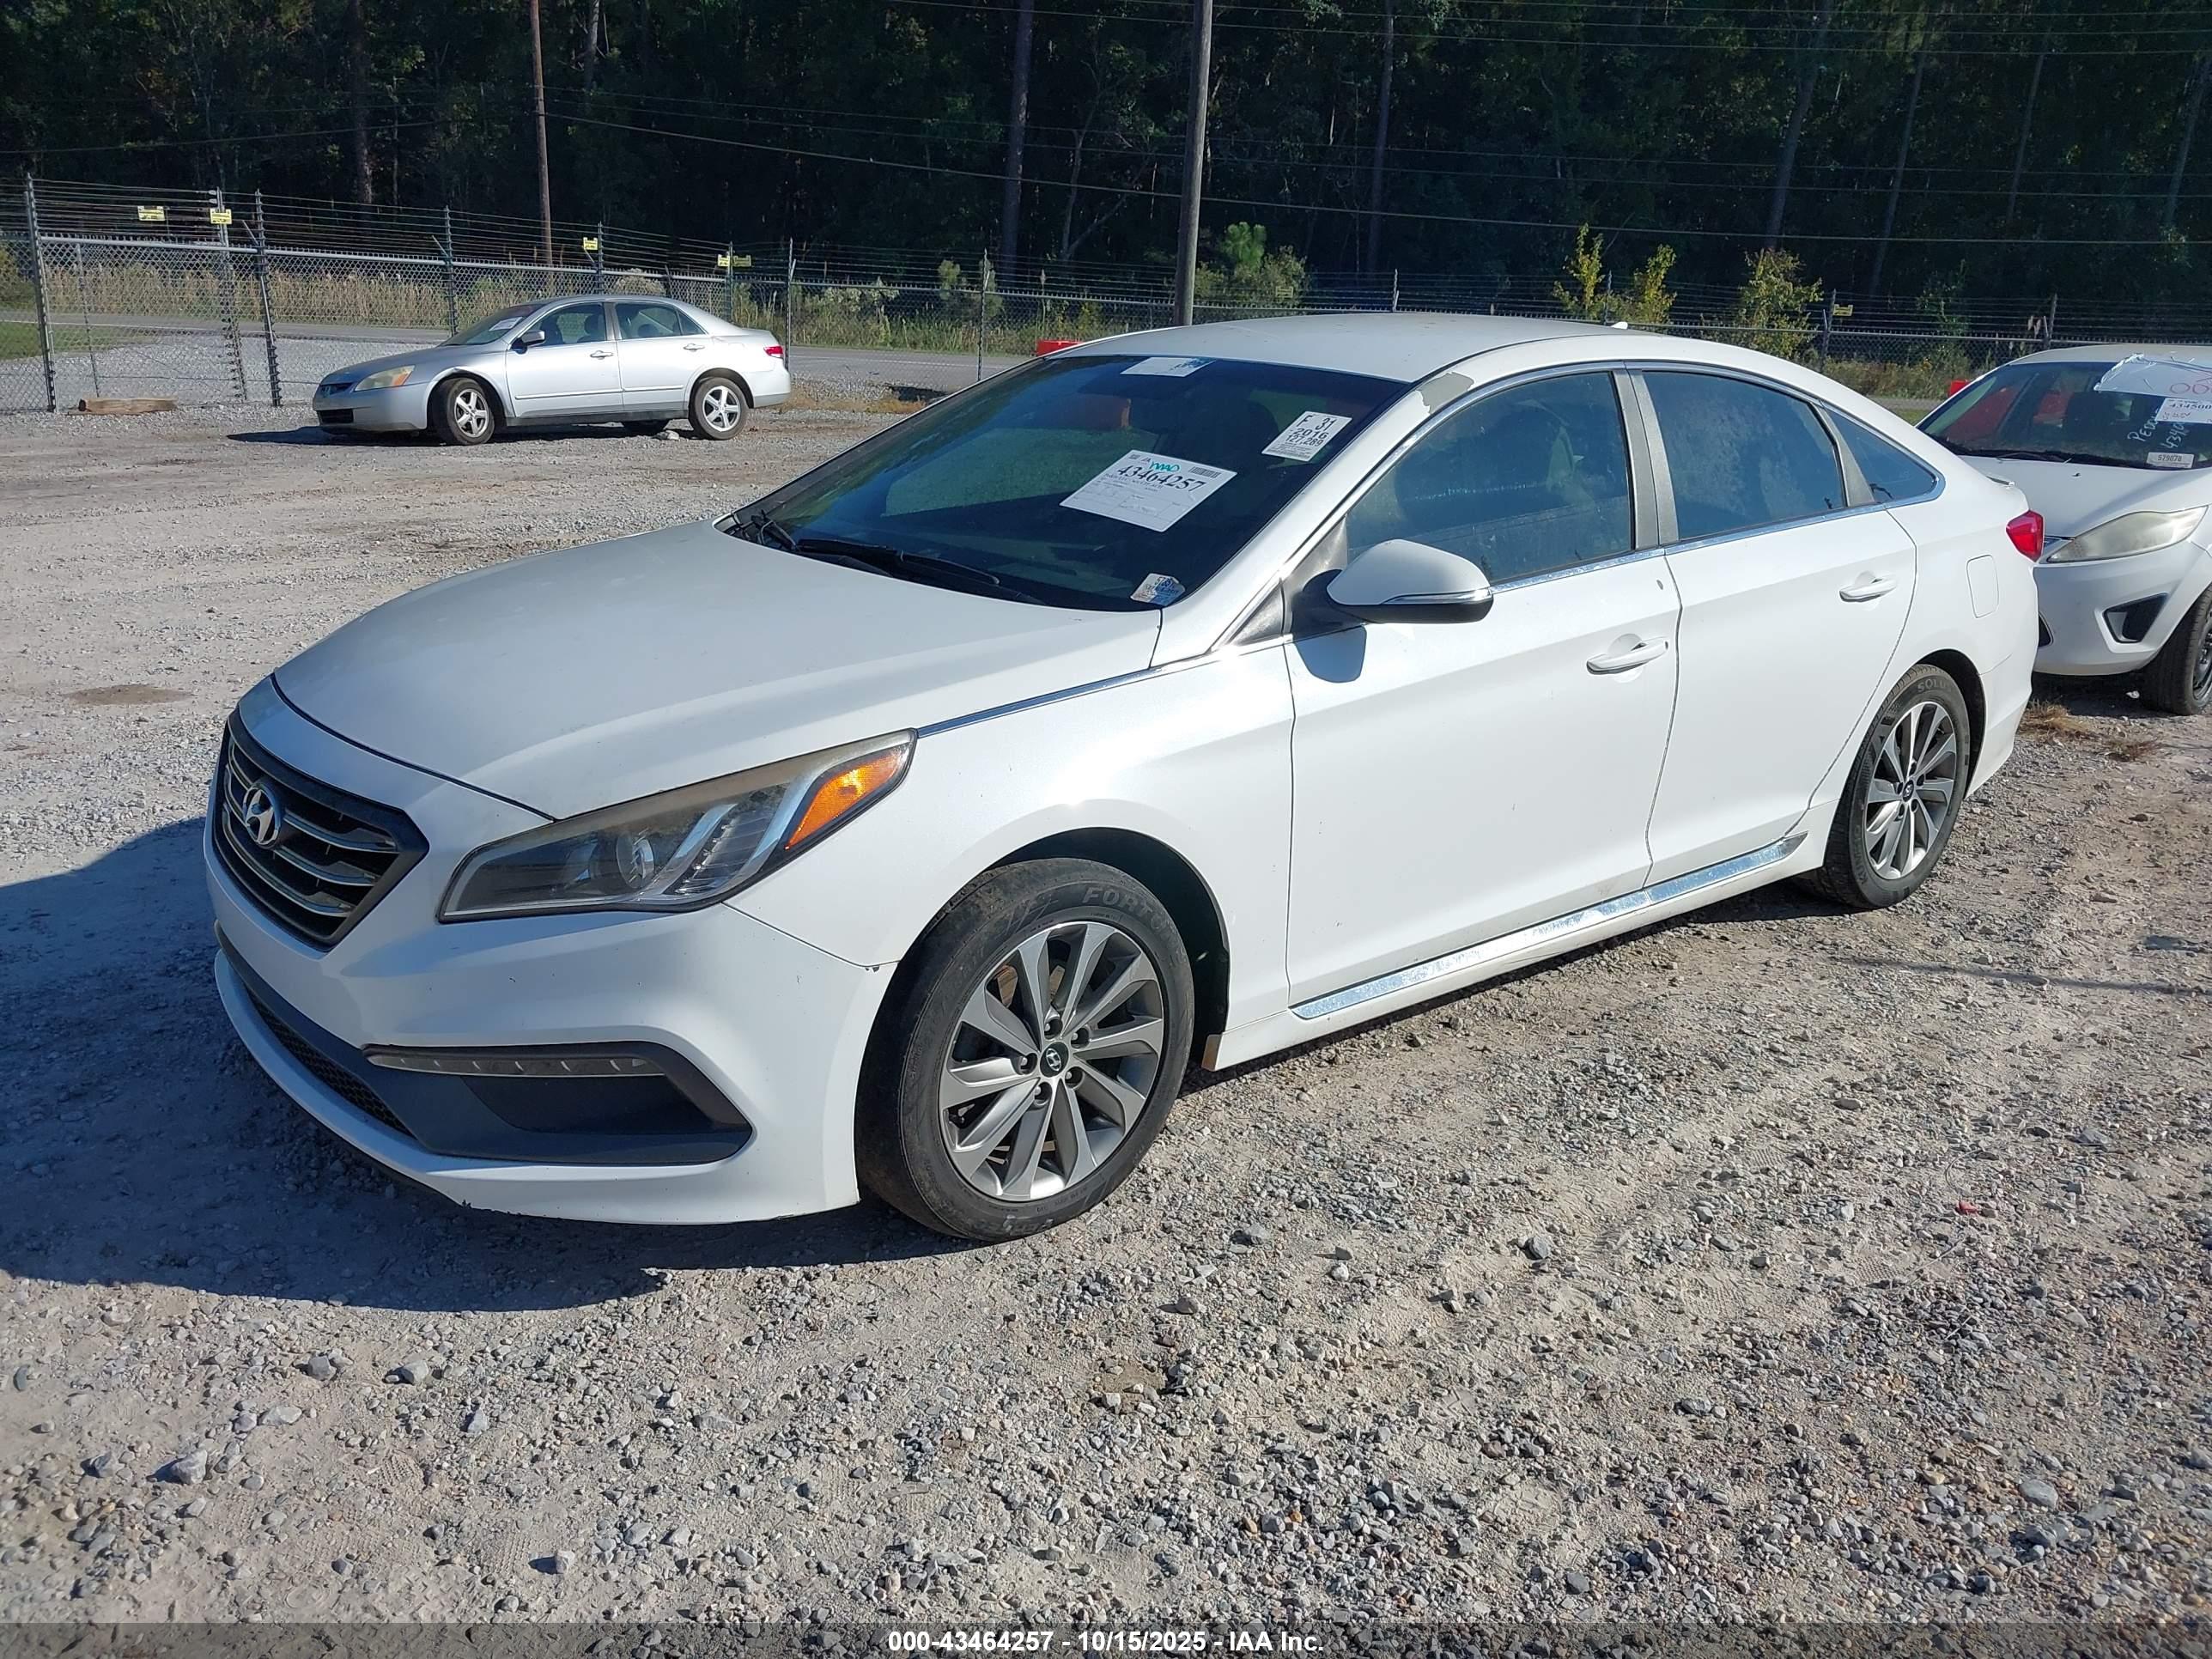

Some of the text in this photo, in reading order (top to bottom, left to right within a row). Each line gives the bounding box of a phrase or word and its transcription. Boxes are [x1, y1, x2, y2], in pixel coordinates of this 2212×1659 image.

[1315, 417, 1338, 432] 31
[1285, 434, 1324, 447] 127,289
[1292, 428, 1329, 440] 2016
[1117, 465, 1207, 492] 43464257
